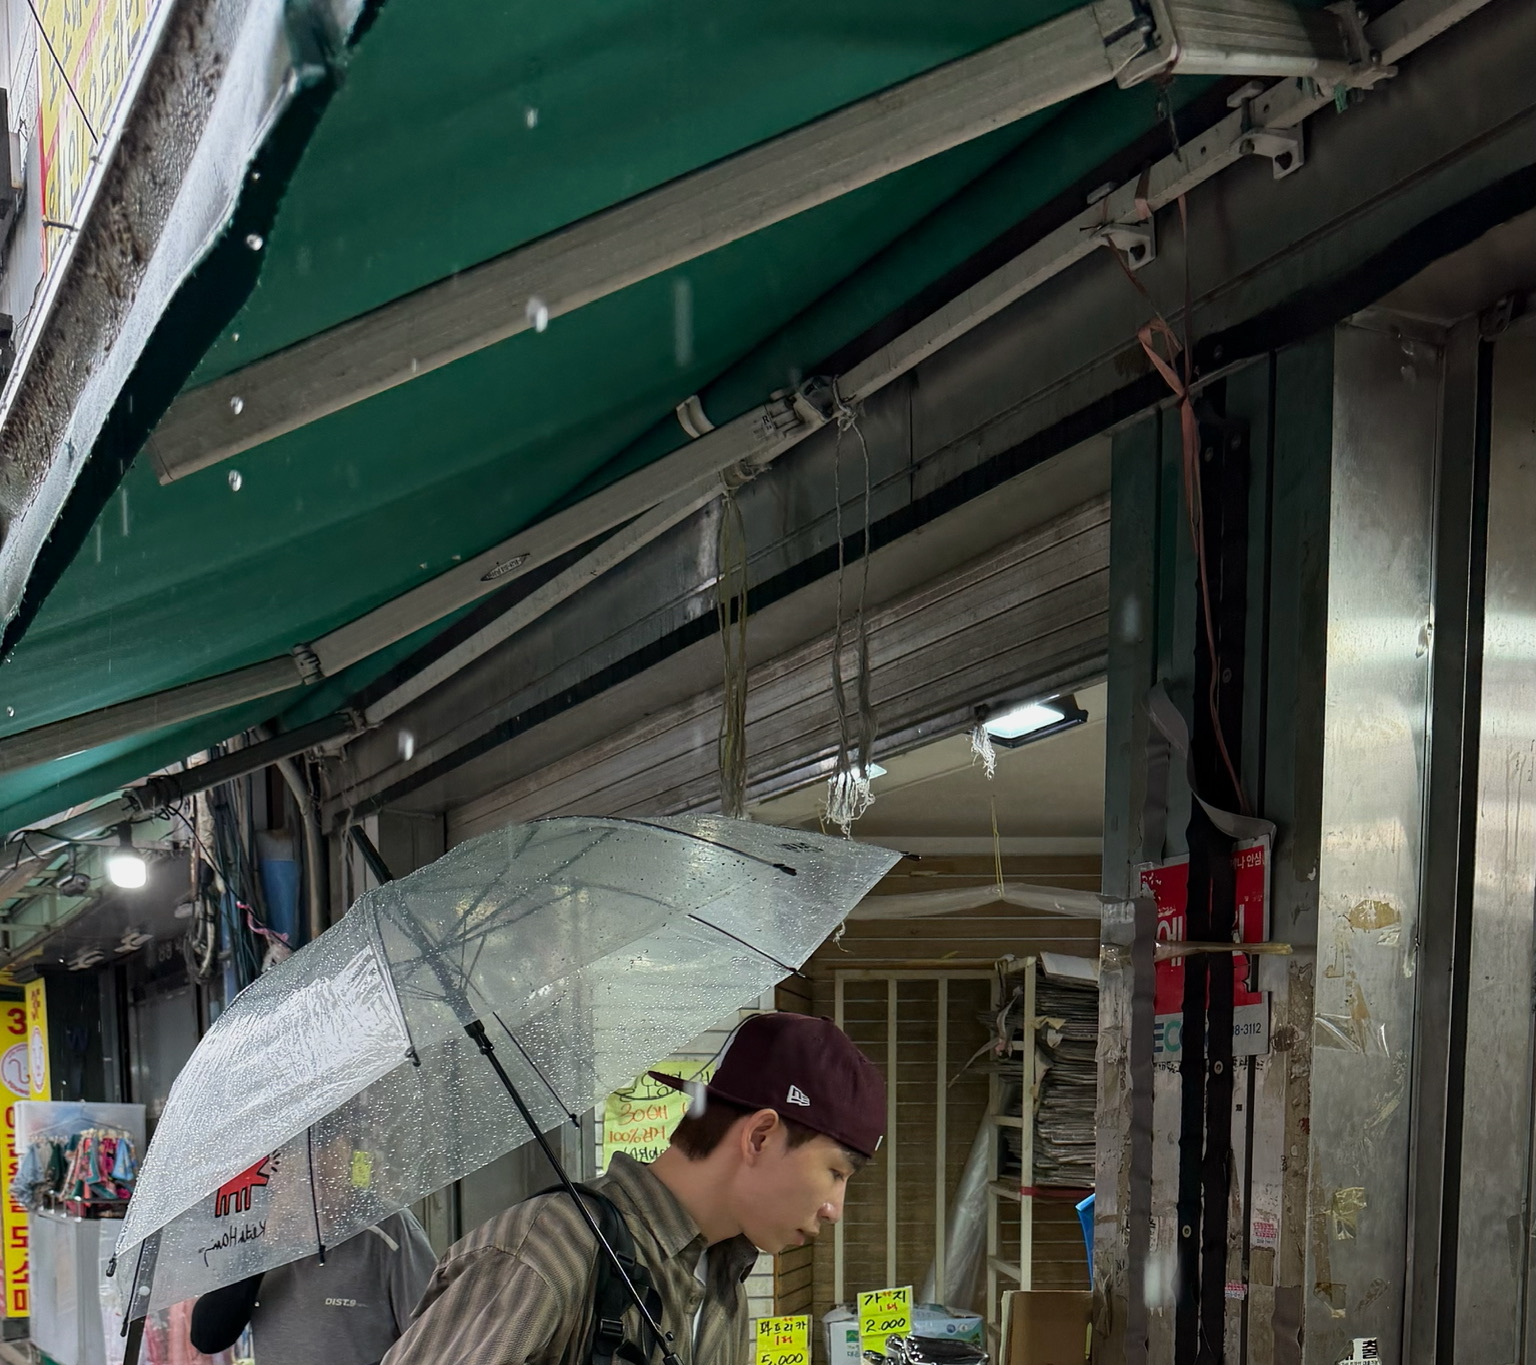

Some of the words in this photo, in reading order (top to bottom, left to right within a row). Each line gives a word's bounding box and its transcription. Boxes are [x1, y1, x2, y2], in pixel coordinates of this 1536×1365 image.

[1246, 851, 1265, 868] 안심
[1232, 1022, 1262, 1038] 8-3112
[864, 1290, 906, 1306] 가지
[865, 1317, 906, 1333] 2.000
